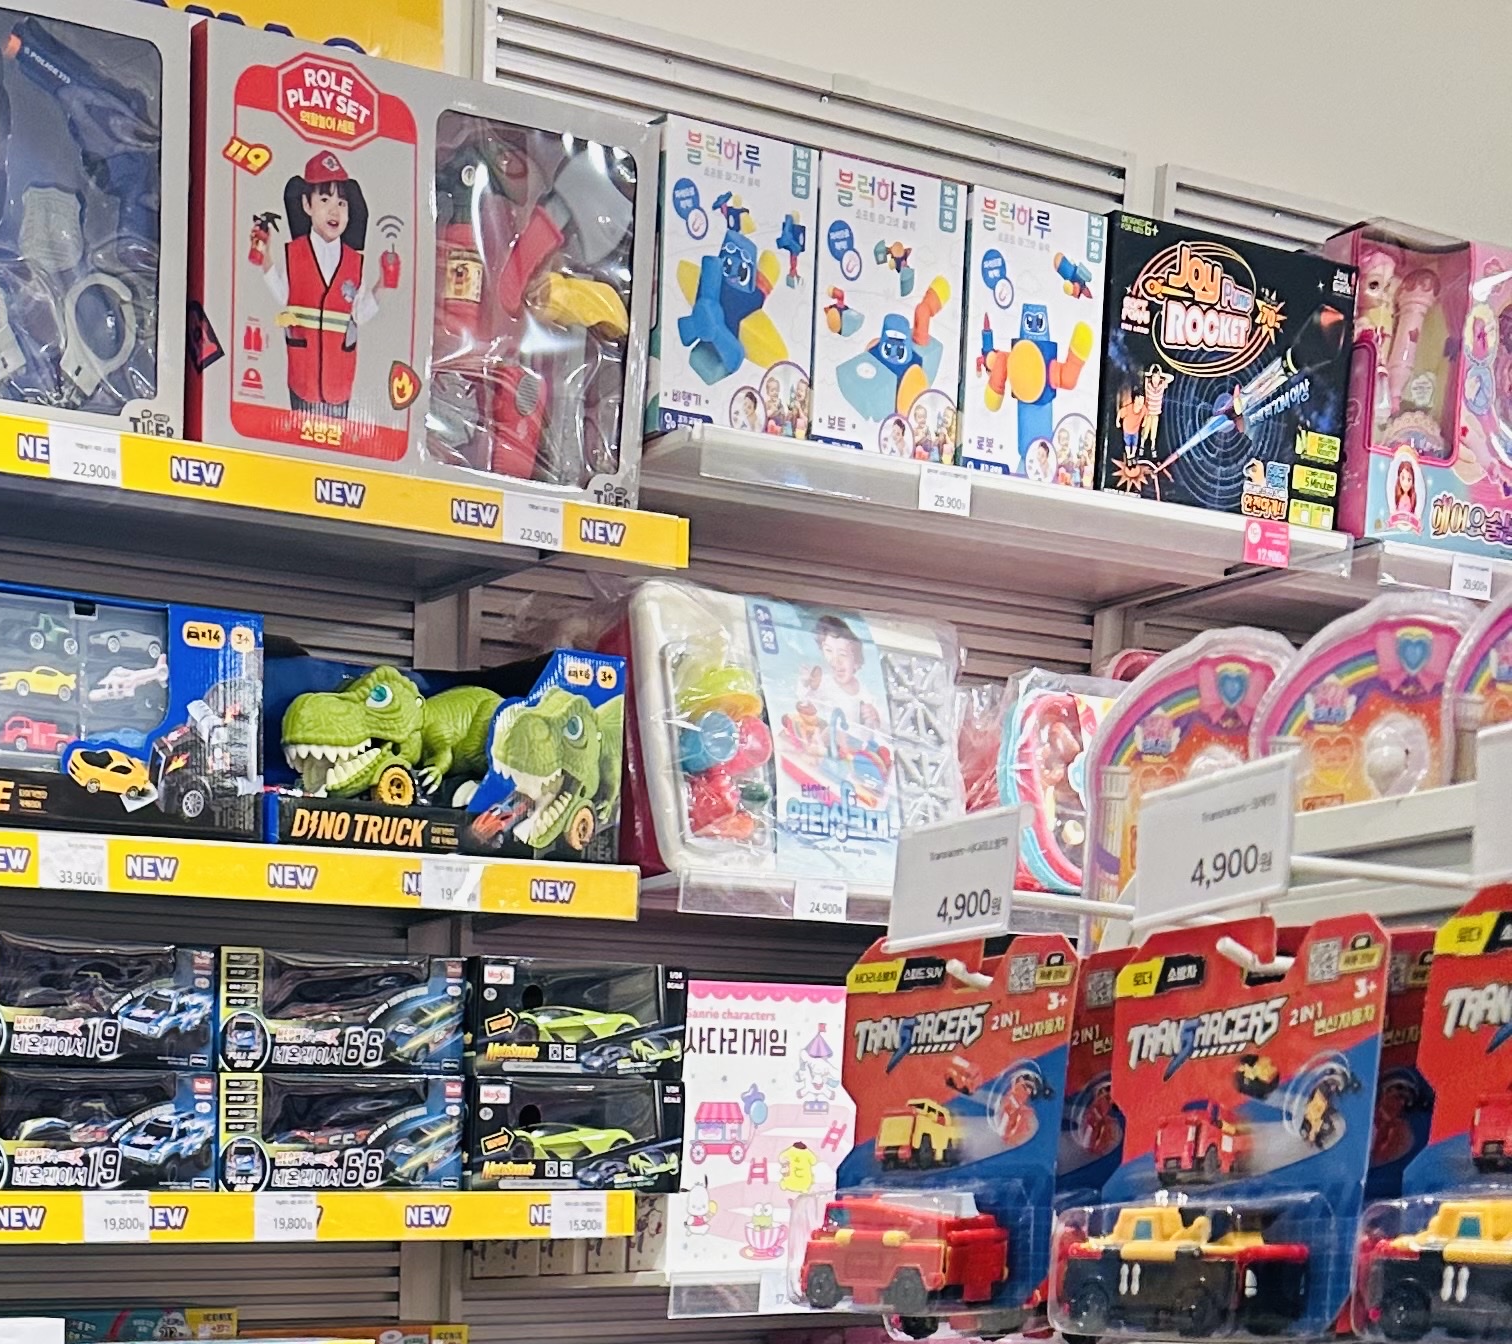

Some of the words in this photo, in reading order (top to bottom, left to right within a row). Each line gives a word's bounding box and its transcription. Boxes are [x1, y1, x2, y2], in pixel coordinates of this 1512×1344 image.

[302, 68, 355, 95] ROLE
[286, 88, 332, 113] PLAY
[332, 96, 371, 125] SET
[227, 138, 271, 173] 119
[686, 129, 762, 174] 블럭하루
[836, 168, 918, 216] 블럭하루
[980, 196, 1052, 238] 블럭하루
[1144, 222, 1160, 237] 6+
[1169, 243, 1223, 304] Joy
[1164, 302, 1250, 348] ROCKET
[671, 389, 703, 408] 비행기
[299, 417, 343, 447] 소방관
[827, 414, 847, 433] 보트
[72, 459, 118, 482] 22,900원
[170, 456, 224, 488] NEW
[315, 478, 365, 508] NEW
[451, 498, 499, 528] NEW
[934, 493, 967, 512] 25,900원
[519, 527, 559, 549] 22,900원
[580, 518, 626, 546] NEW
[291, 807, 349, 842] DINO
[352, 811, 428, 848] TRUCK
[125, 853, 178, 882] NEW
[267, 862, 319, 890] NEW
[1191, 843, 1273, 890] 4,900원
[529, 880, 575, 905] NEW
[809, 900, 843, 916] 24,900원
[937, 887, 1002, 925] 4,900원
[1047, 991, 1068, 1011] 3+
[1354, 977, 1377, 999] 3+
[686, 1007, 729, 1021] Sanrio
[731, 1008, 776, 1023] characters
[10, 1034, 87, 1058] 네온레이서
[88, 1018, 122, 1059] 19
[272, 1044, 343, 1067] 네온레이서
[343, 1026, 385, 1066] 66
[685, 1026, 789, 1059] 사다리게임
[11, 1165, 88, 1187] 네온레이서
[88, 1147, 123, 1188] 19
[271, 1166, 343, 1188] 네온레이서
[343, 1148, 384, 1188] 66
[103, 1216, 145, 1233] 19,800원
[272, 1215, 314, 1233] 19,800원
[404, 1204, 451, 1229] NEW
[568, 1217, 604, 1233] 15,900원
